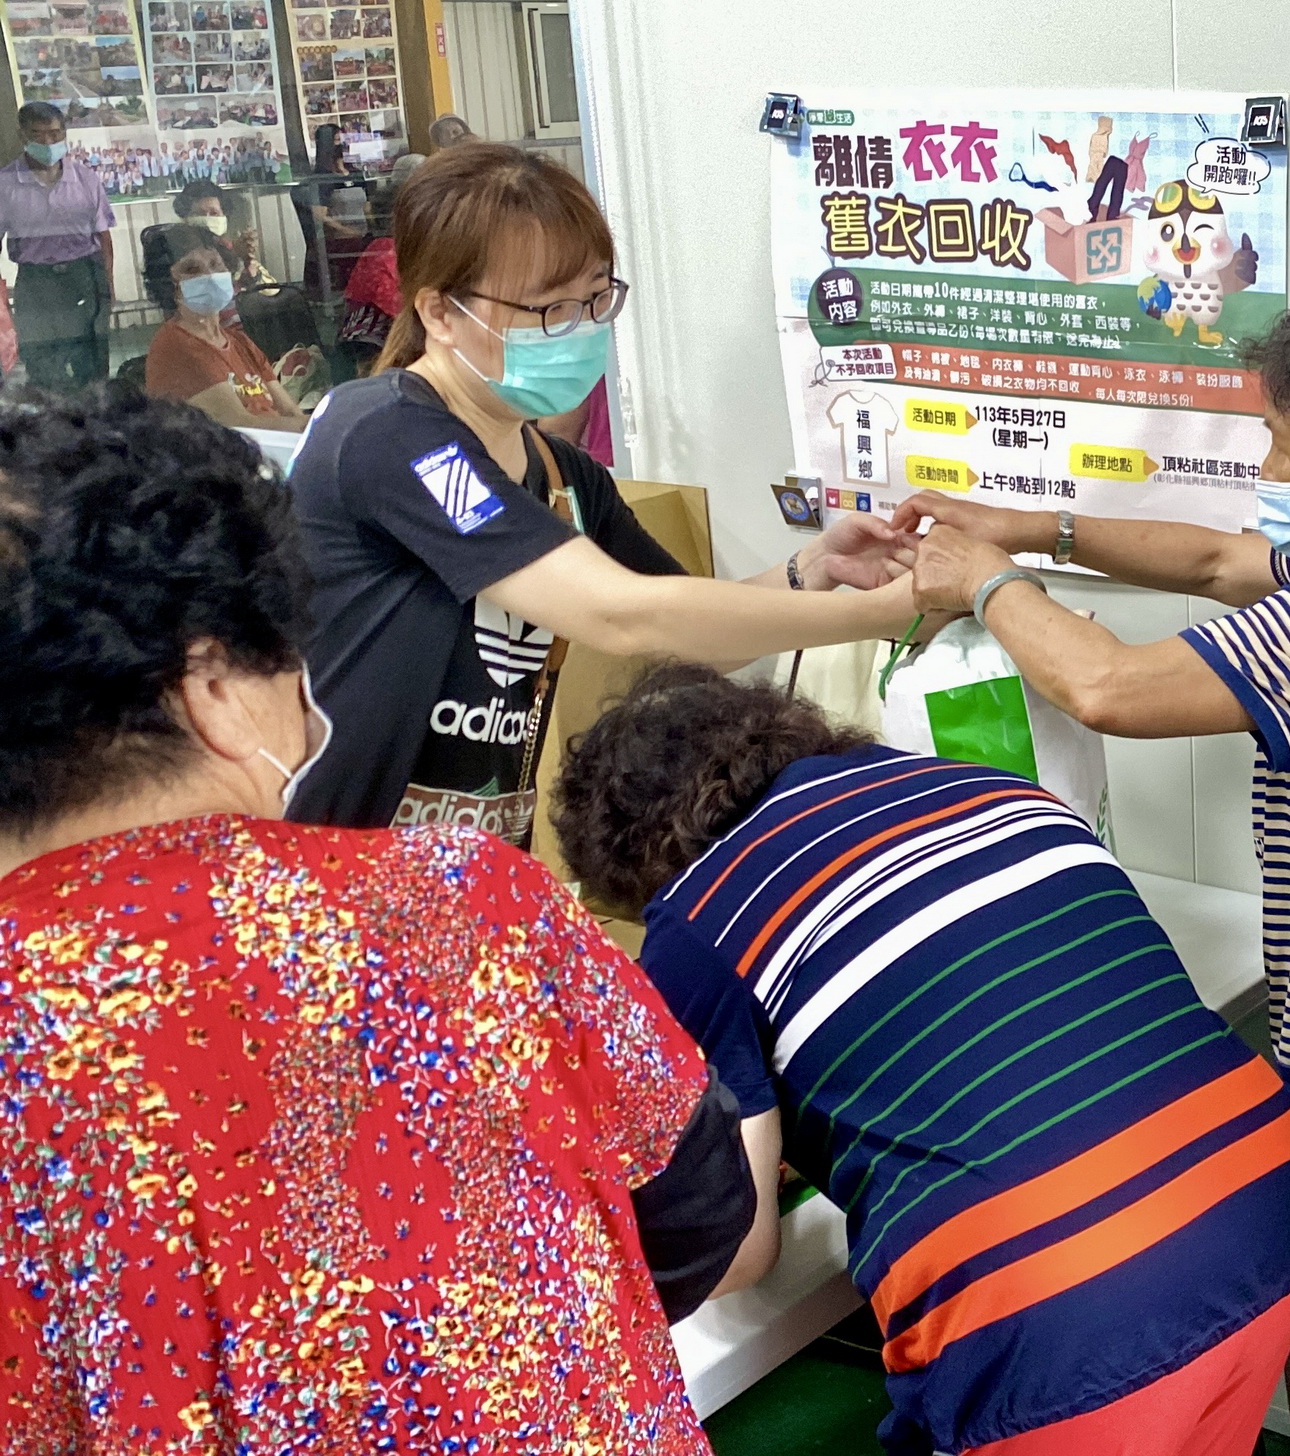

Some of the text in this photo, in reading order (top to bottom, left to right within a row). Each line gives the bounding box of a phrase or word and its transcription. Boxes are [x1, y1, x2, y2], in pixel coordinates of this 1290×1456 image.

[1216, 145, 1247, 166] 活動
[821, 191, 1032, 271] 舊衣回收
[822, 278, 854, 300] 活動
[828, 300, 858, 321] 內容
[842, 347, 883, 361] 本次活動
[836, 362, 895, 377] 不予回收項目
[912, 407, 957, 427] 活動日期
[974, 406, 1066, 429] 113年5月27日
[855, 409, 874, 481] 福興鄉
[992, 427, 1050, 451] (星期一)
[1082, 453, 1133, 473] 辦理地點
[1162, 456, 1260, 480] 頂粘社區活動中
[915, 465, 959, 485] 活動時間
[979, 472, 1077, 499] 上午9點到12點
